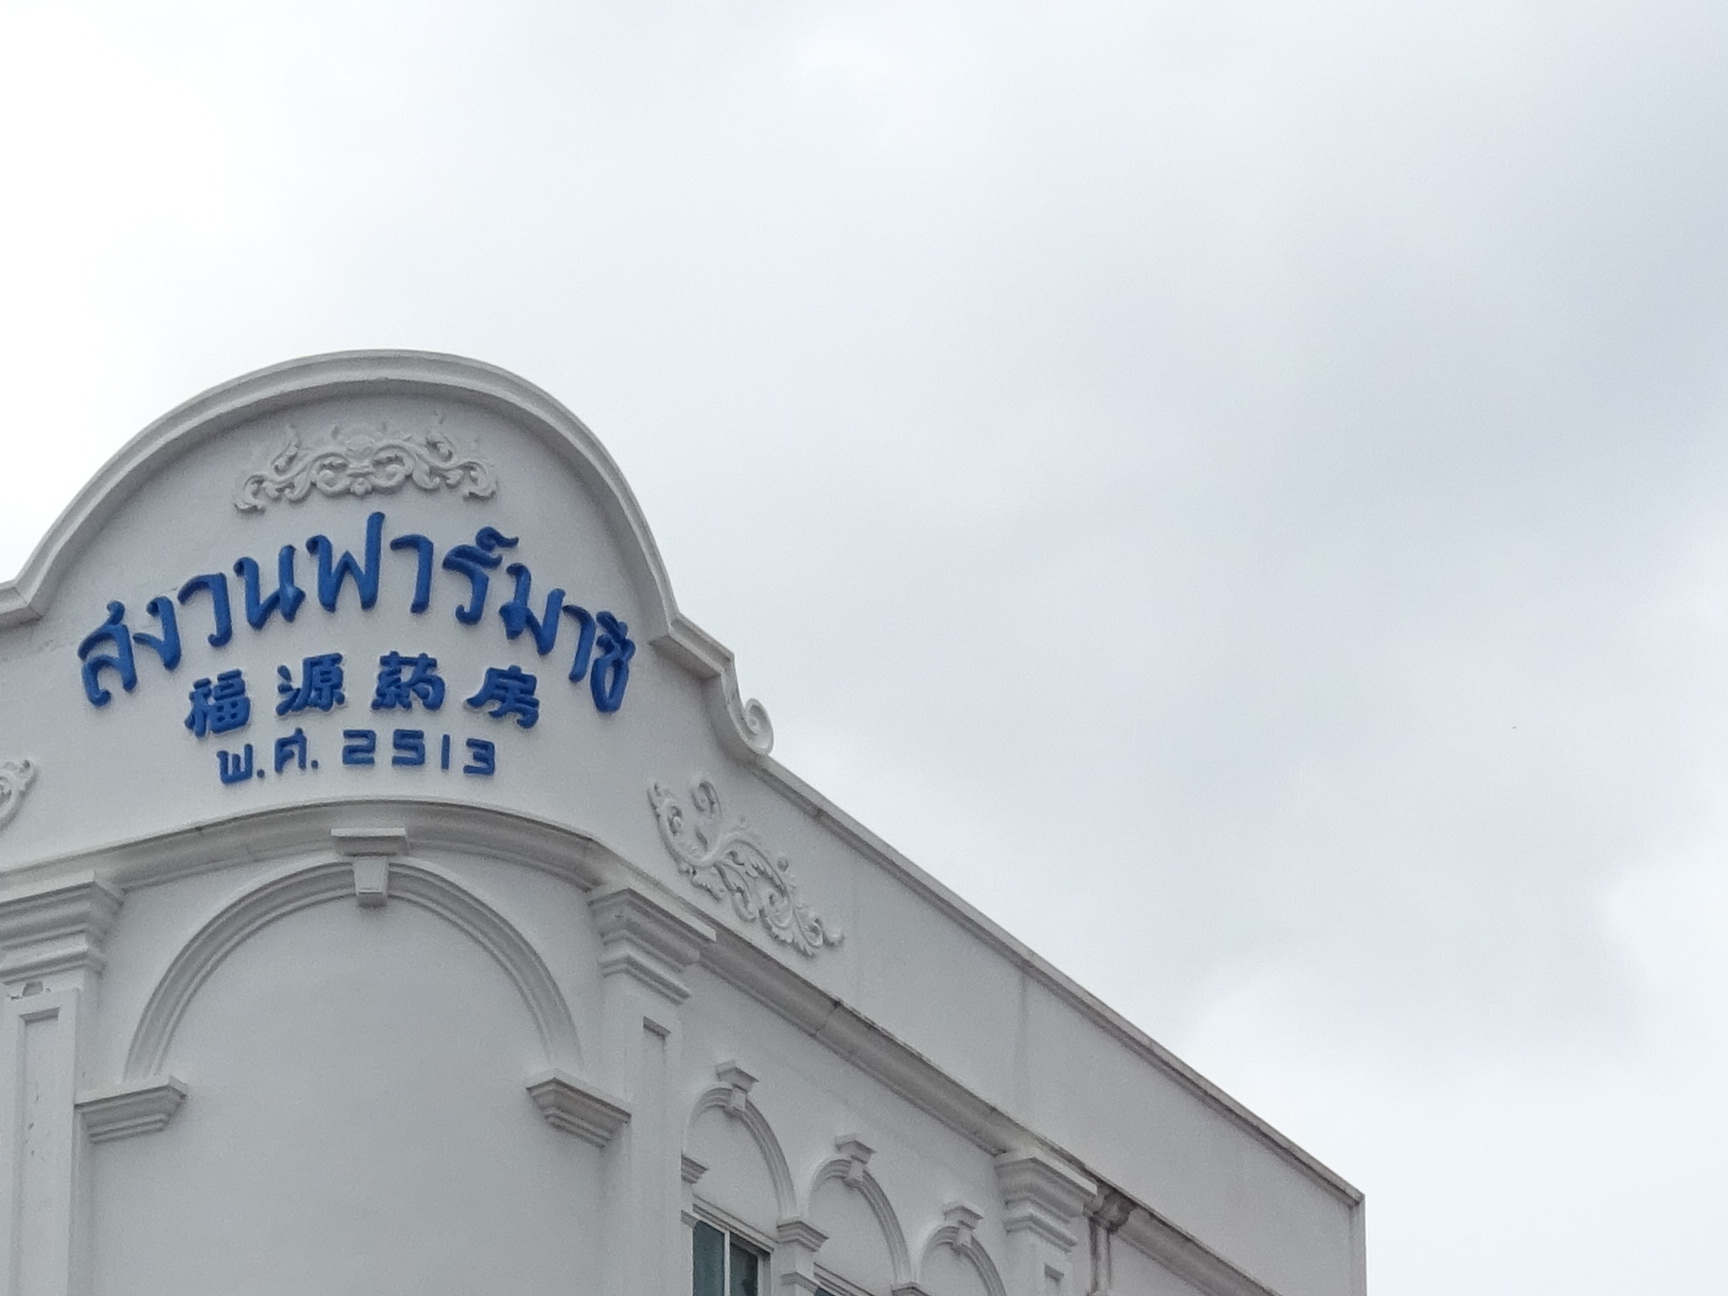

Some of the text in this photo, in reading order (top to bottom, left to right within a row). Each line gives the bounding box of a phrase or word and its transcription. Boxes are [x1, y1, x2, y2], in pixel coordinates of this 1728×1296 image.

[77, 511, 636, 715] สงวนฟาร์มาซี
[216, 728, 497, 786] พ.ศ. 2513
